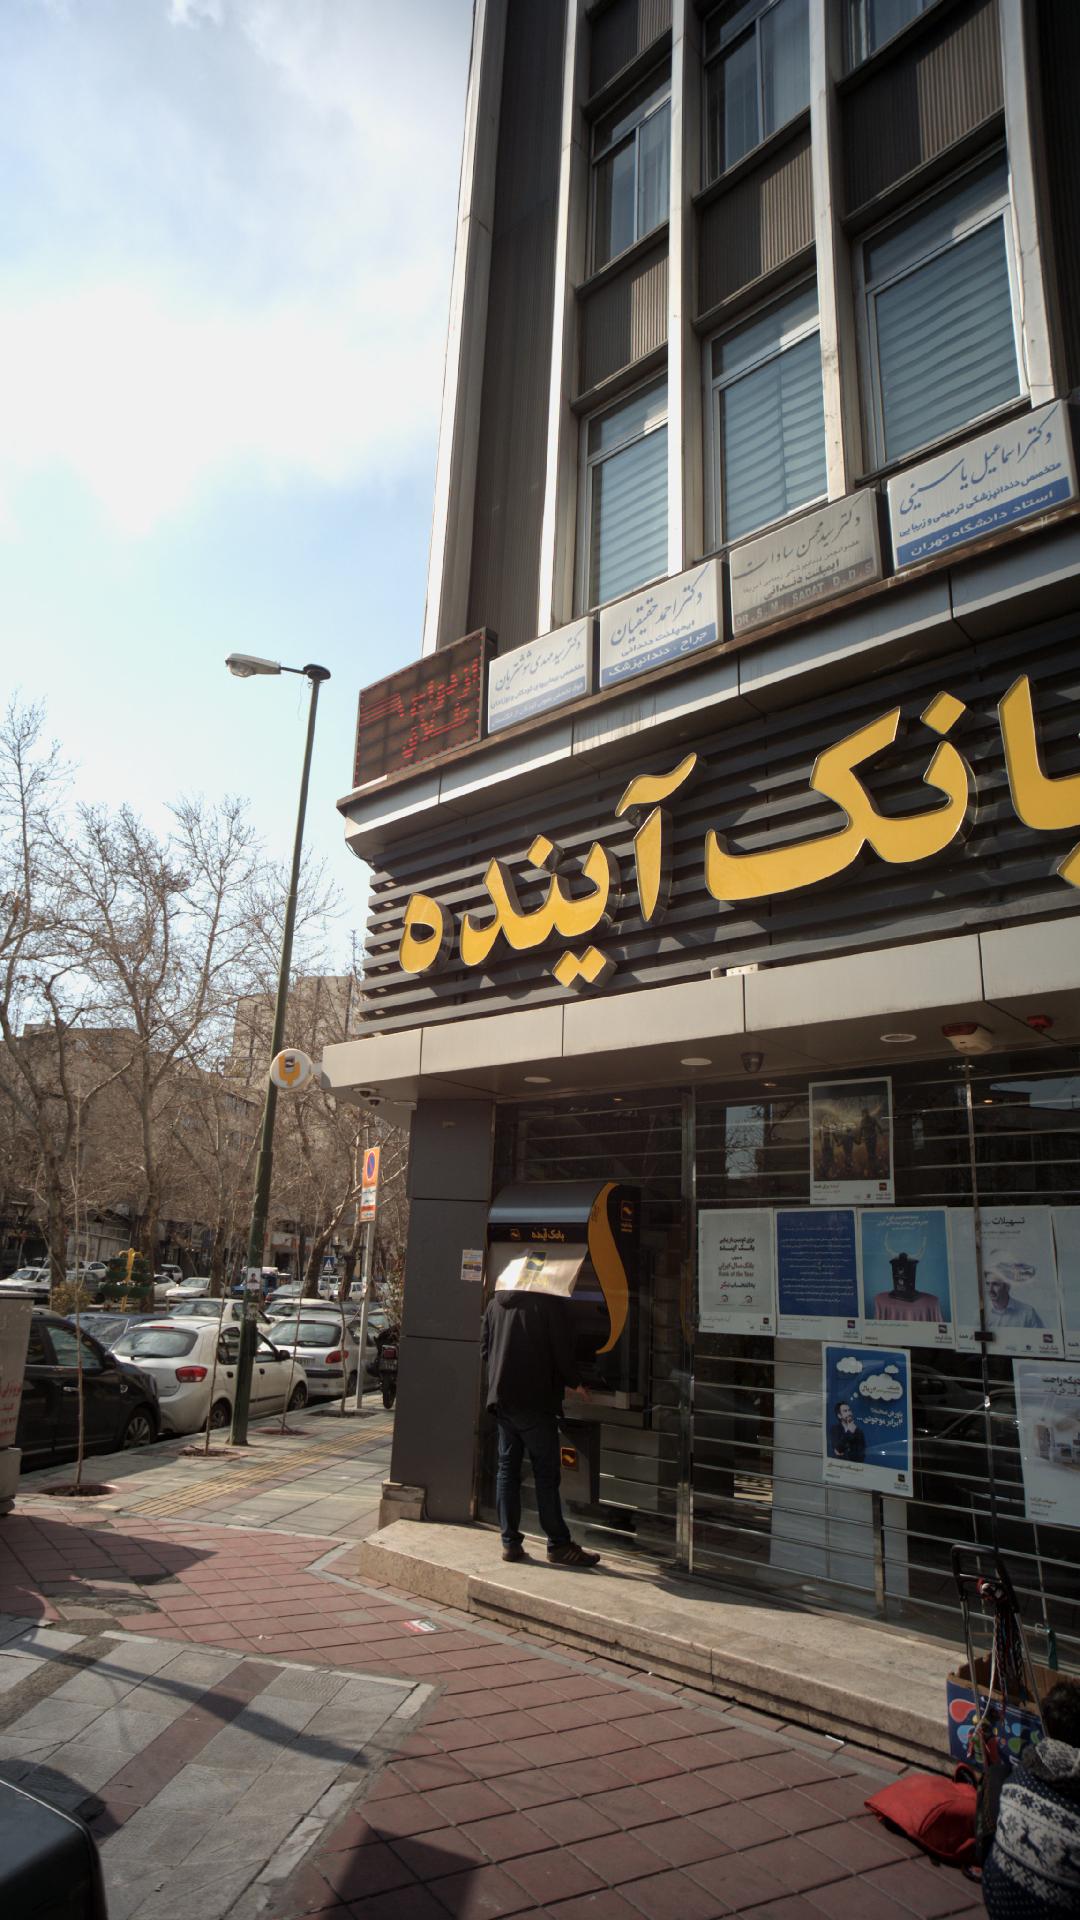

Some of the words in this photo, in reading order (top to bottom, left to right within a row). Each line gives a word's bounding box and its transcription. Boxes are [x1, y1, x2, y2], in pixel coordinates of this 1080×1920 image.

[1017, 403, 1059, 464] دکتر
[970, 442, 1021, 486] اسماعیل
[1021, 461, 1062, 487] متخصص
[933, 502, 966, 524] ترمیمی
[1011, 490, 1054, 514] استاد
[832, 494, 864, 544] دکتر
[951, 511, 1009, 539] دانشگاه
[796, 520, 824, 559] محسن
[910, 534, 951, 557] تهران
[732, 545, 795, 581] سادات
[805, 558, 840, 581] ایمپلنت
[672, 562, 710, 623] دکتر
[763, 575, 804, 601] دندانی
[792, 582, 825, 603] SADAT
[655, 598, 677, 625] احمد
[655, 619, 695, 642] ایمپلنت
[680, 631, 708, 652] جراح
[621, 640, 654, 658] دندانی
[608, 648, 670, 677] دندانپزشک
[705, 674, 1080, 900] انک
[398, 753, 697, 988] آینده
[531, 1228, 549, 1242] آینده
[991, 1216, 1026, 1228] تسهیلات
[549, 1228, 566, 1243] بانک
